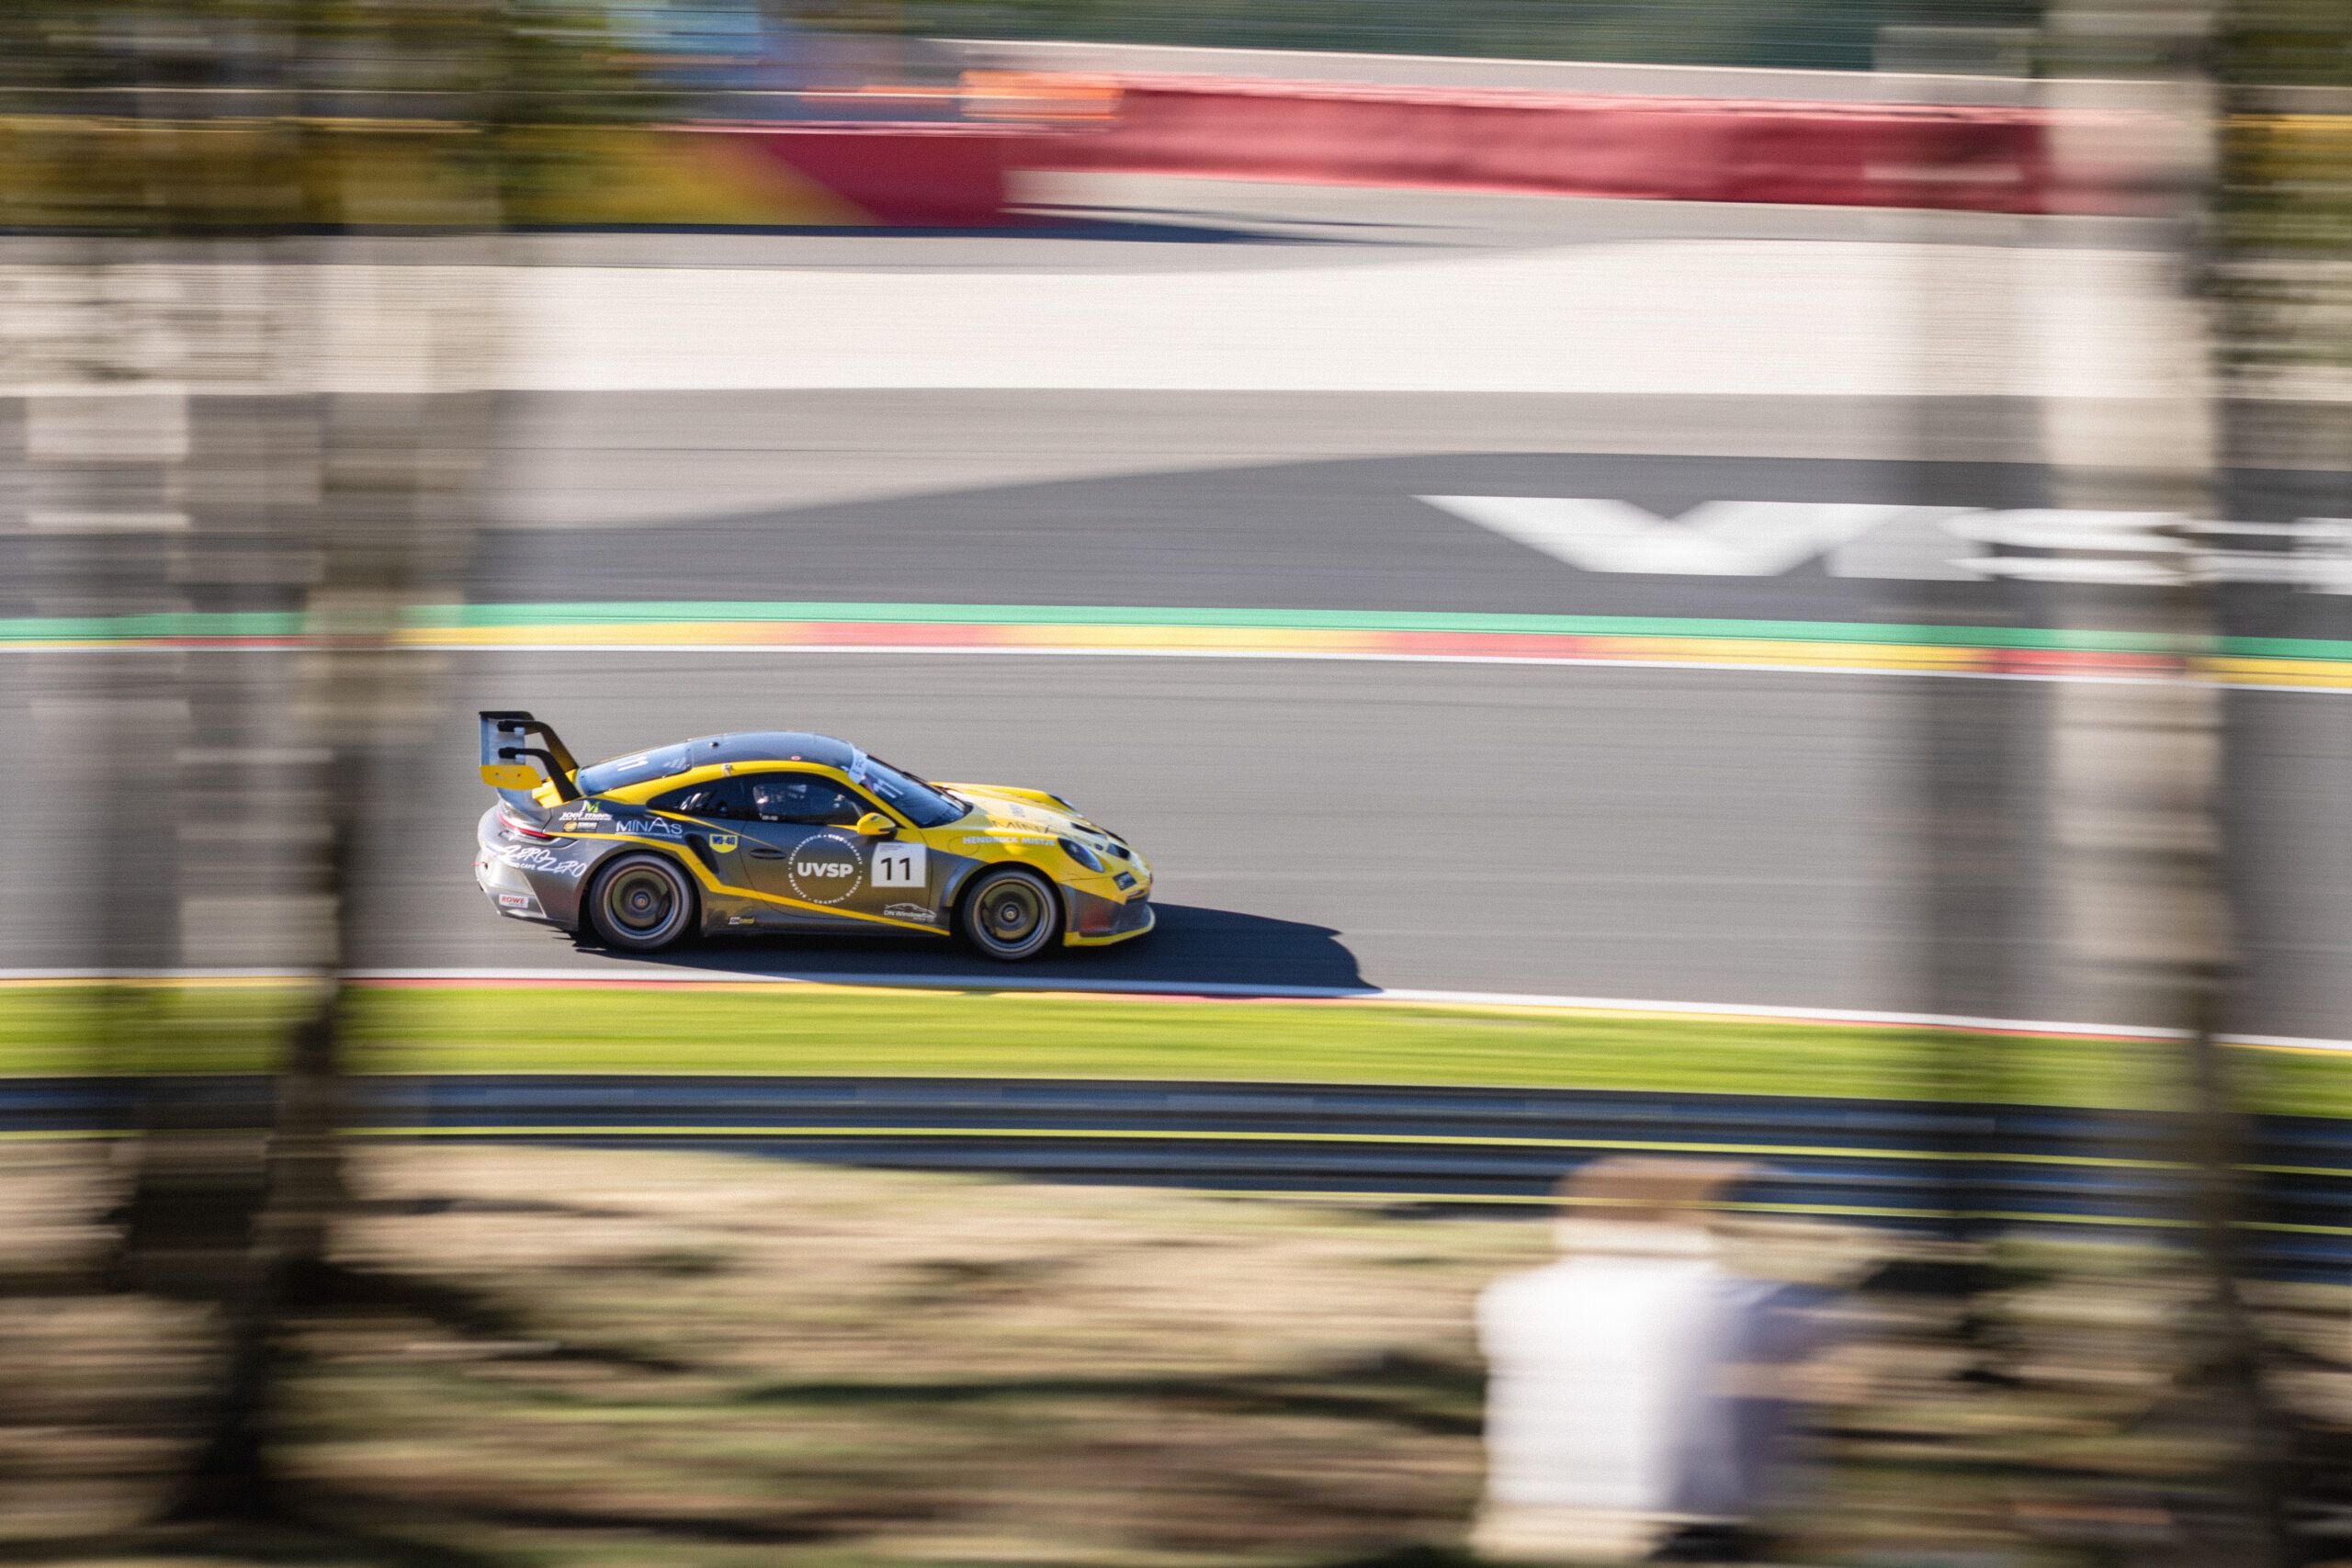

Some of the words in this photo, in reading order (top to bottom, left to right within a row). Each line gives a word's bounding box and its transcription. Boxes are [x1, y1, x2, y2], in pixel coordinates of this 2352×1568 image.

[797, 862, 854, 878] UVSP
[880, 857, 910, 881] 11
[501, 896, 526, 905] ROWE
